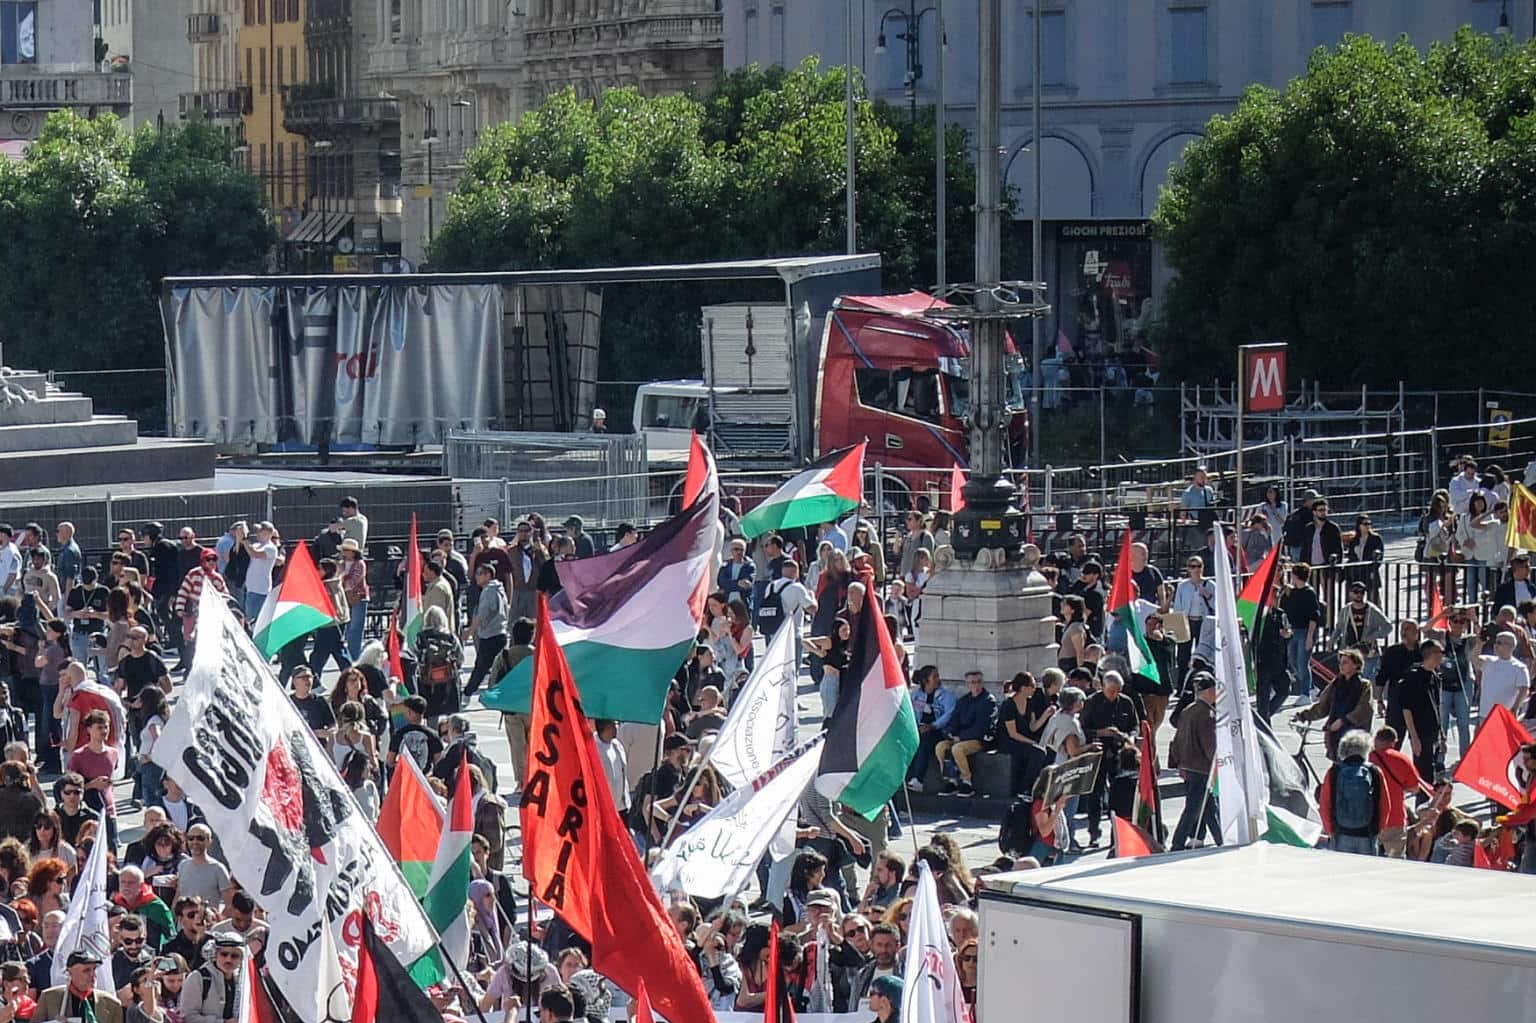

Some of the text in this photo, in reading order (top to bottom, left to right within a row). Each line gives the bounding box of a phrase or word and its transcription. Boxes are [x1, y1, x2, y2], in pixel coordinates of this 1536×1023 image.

[1062, 225, 1097, 236] GIOCHI
[1250, 357, 1283, 399] M
[542, 778, 588, 911] ORIA
